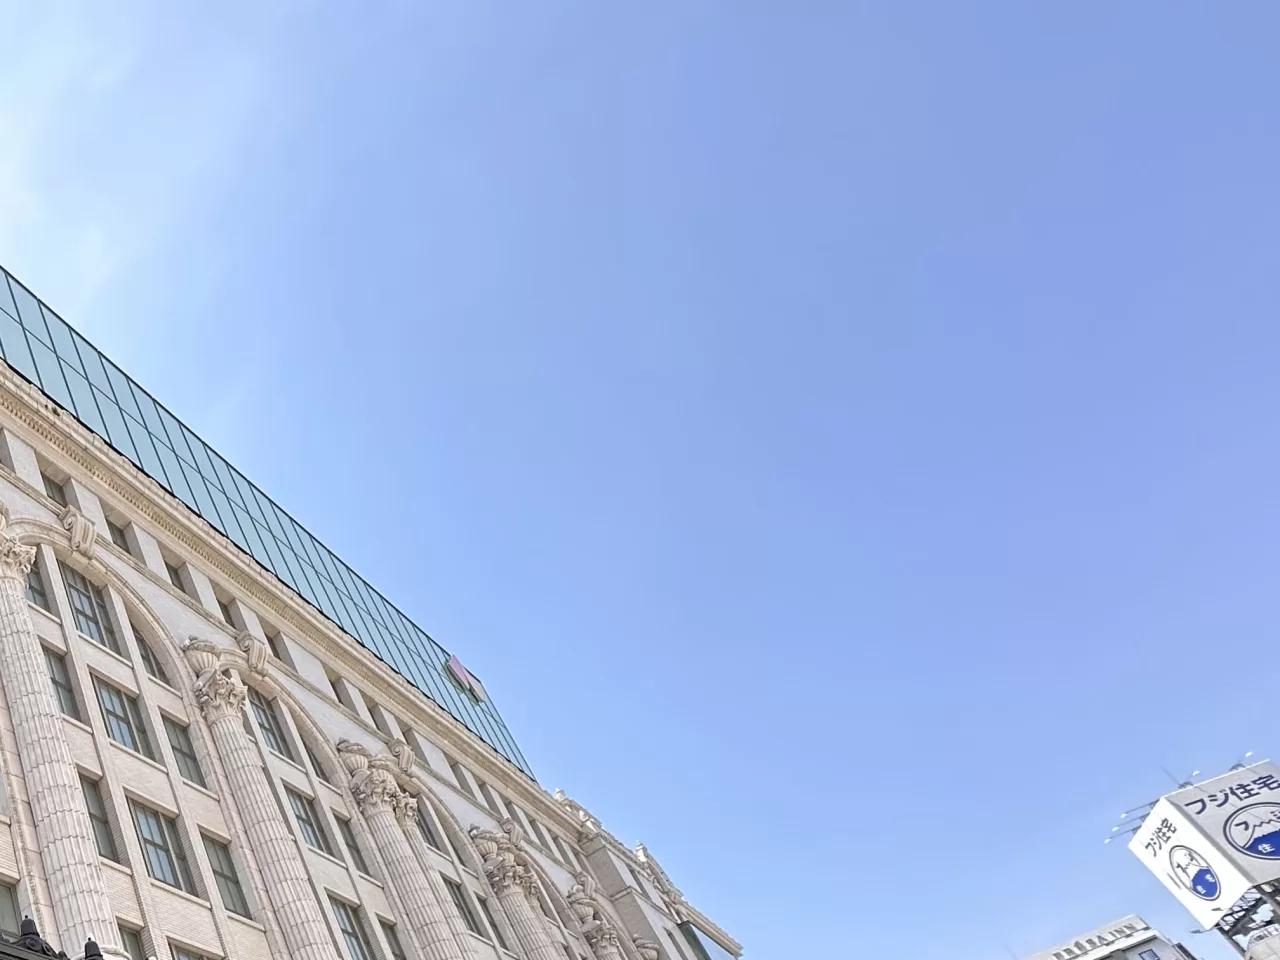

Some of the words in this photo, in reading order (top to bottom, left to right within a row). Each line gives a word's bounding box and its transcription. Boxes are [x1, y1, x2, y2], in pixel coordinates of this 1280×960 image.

[1184, 774, 1280, 815] フジ住宅
[1145, 817, 1177, 857] フジ住宅
